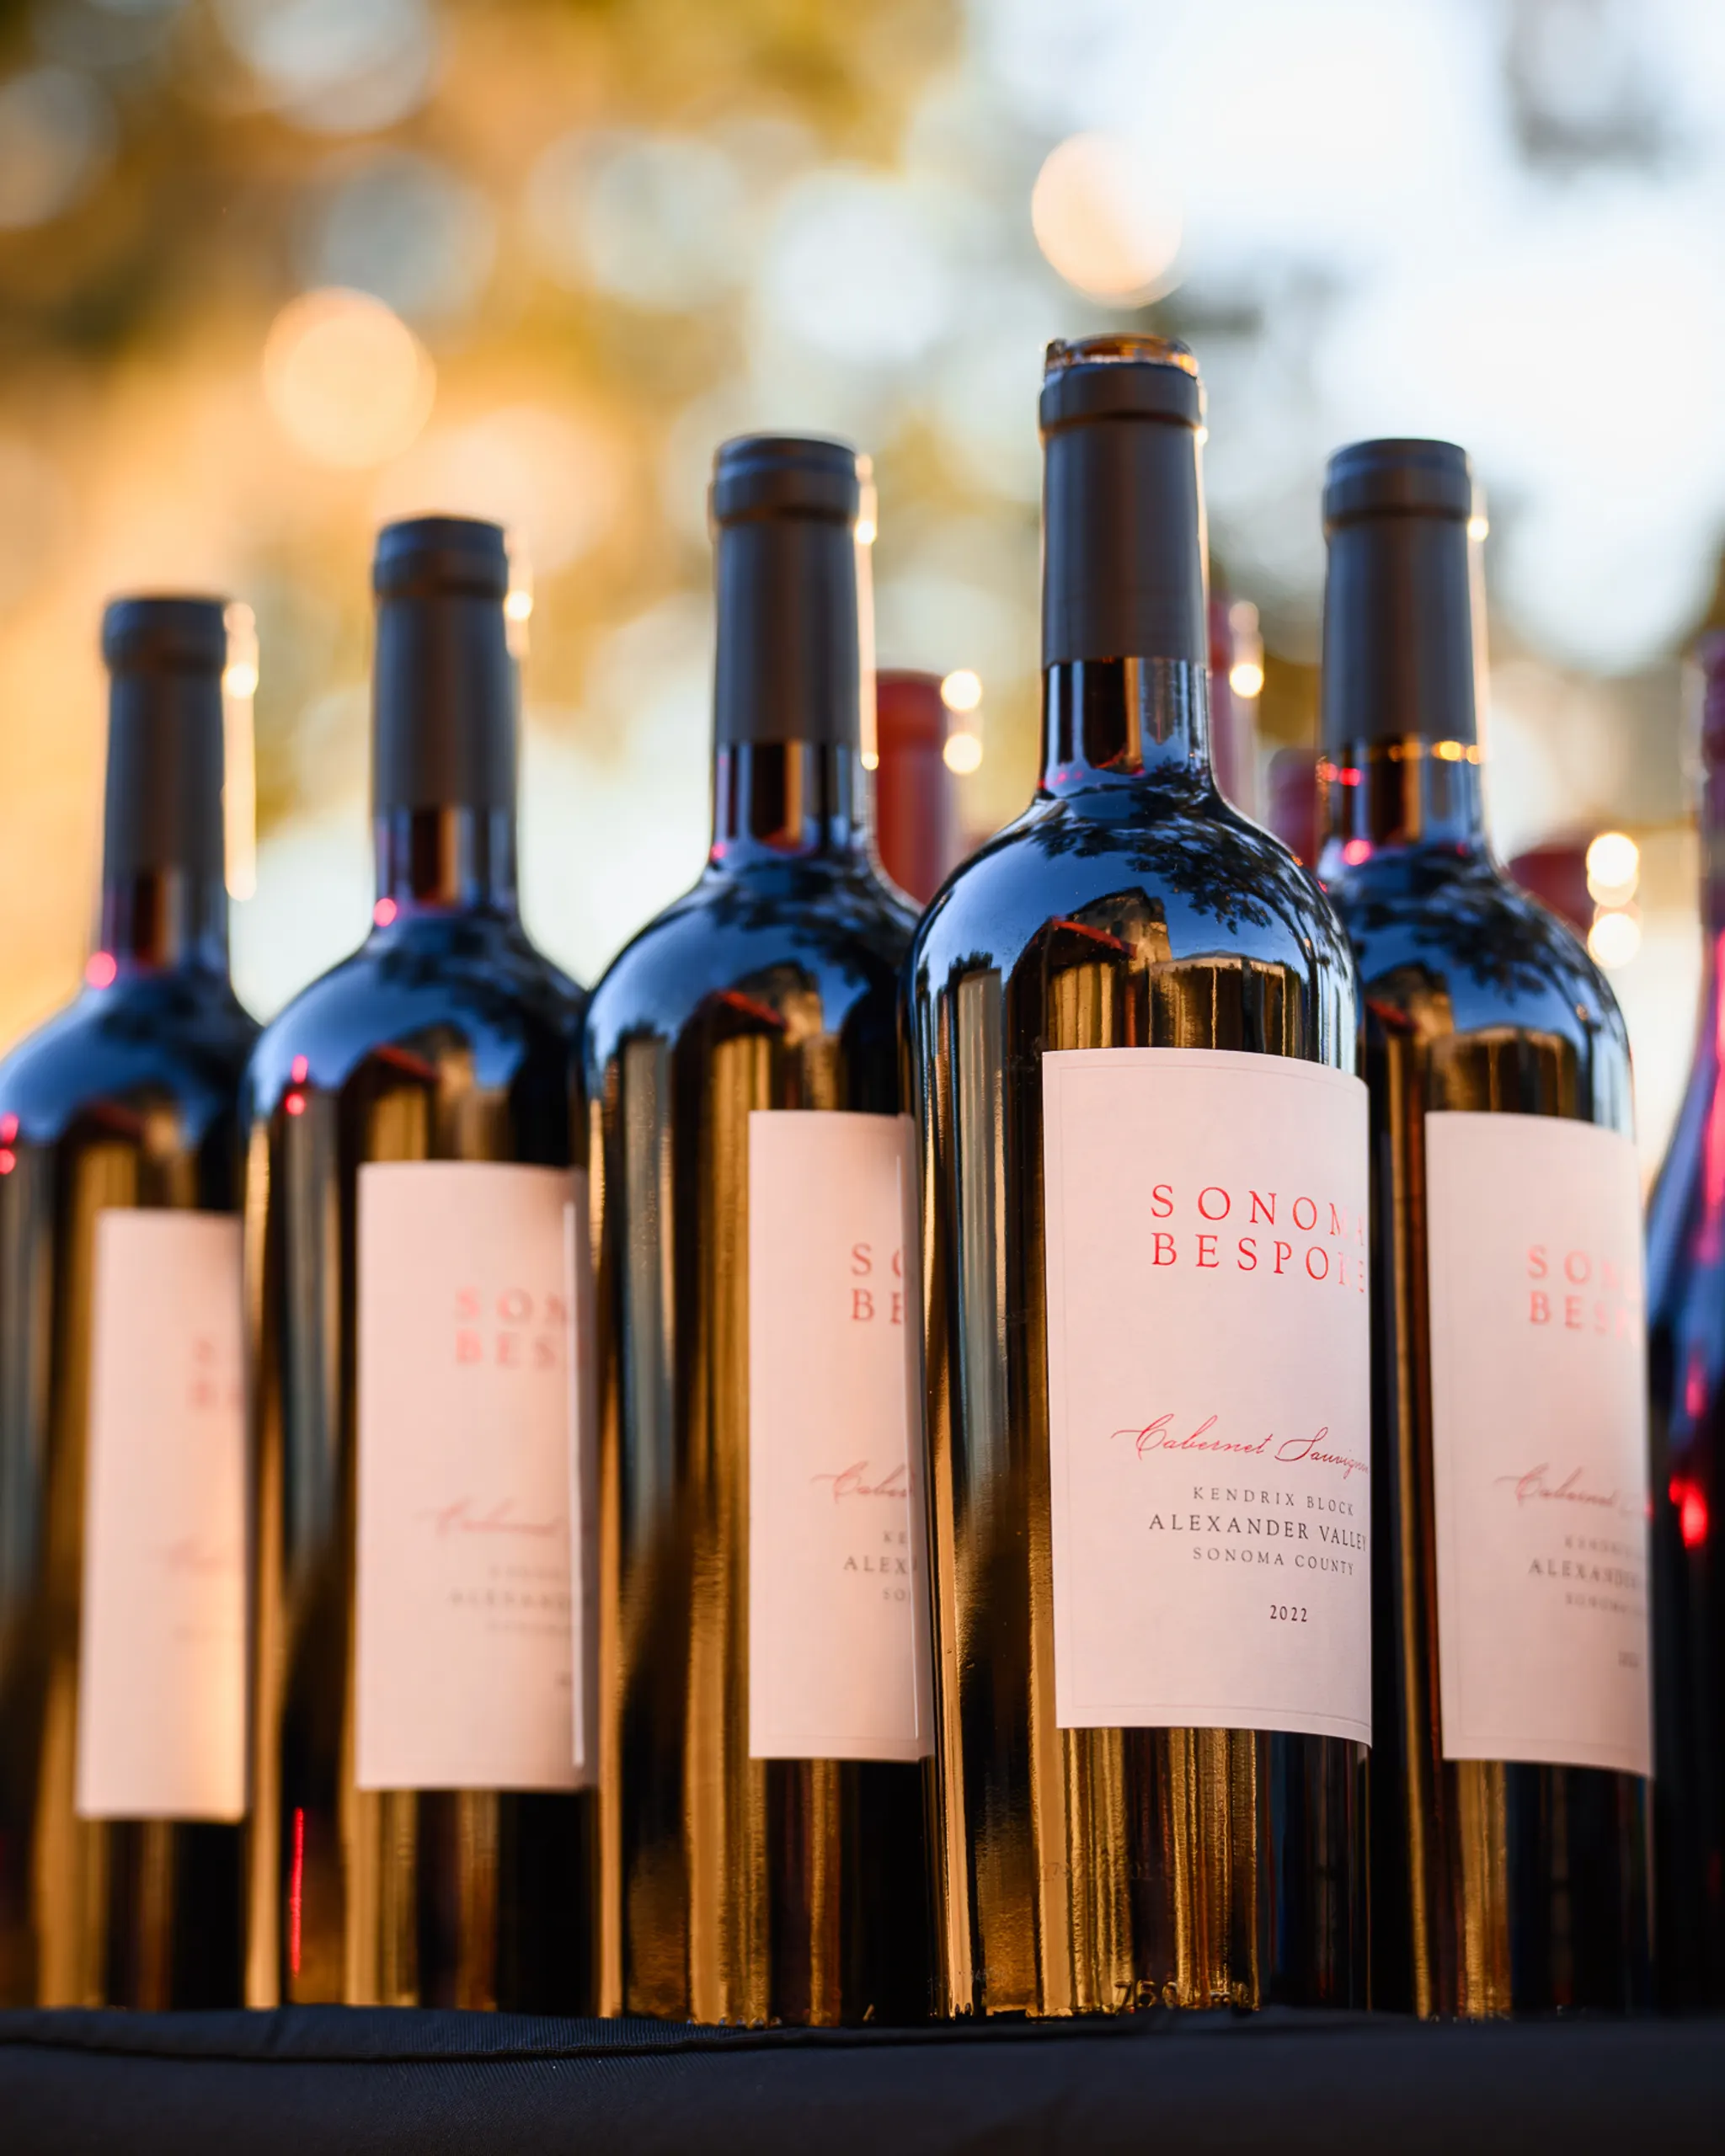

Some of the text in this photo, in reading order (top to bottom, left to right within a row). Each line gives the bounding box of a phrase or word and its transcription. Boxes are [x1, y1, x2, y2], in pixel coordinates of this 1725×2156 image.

[1150, 1183, 1365, 1247] SONOMA
[1151, 1231, 1365, 1294] BESPOKE
[1109, 1412, 1274, 1461] Cabernet
[1192, 1486, 1354, 1517] KENDRIX BLOCK
[1148, 1513, 1368, 1553] ALEXANDER VALLEY
[1192, 1545, 1354, 1576] SONOMA COUNTY
[1269, 1604, 1308, 1623] 2022
